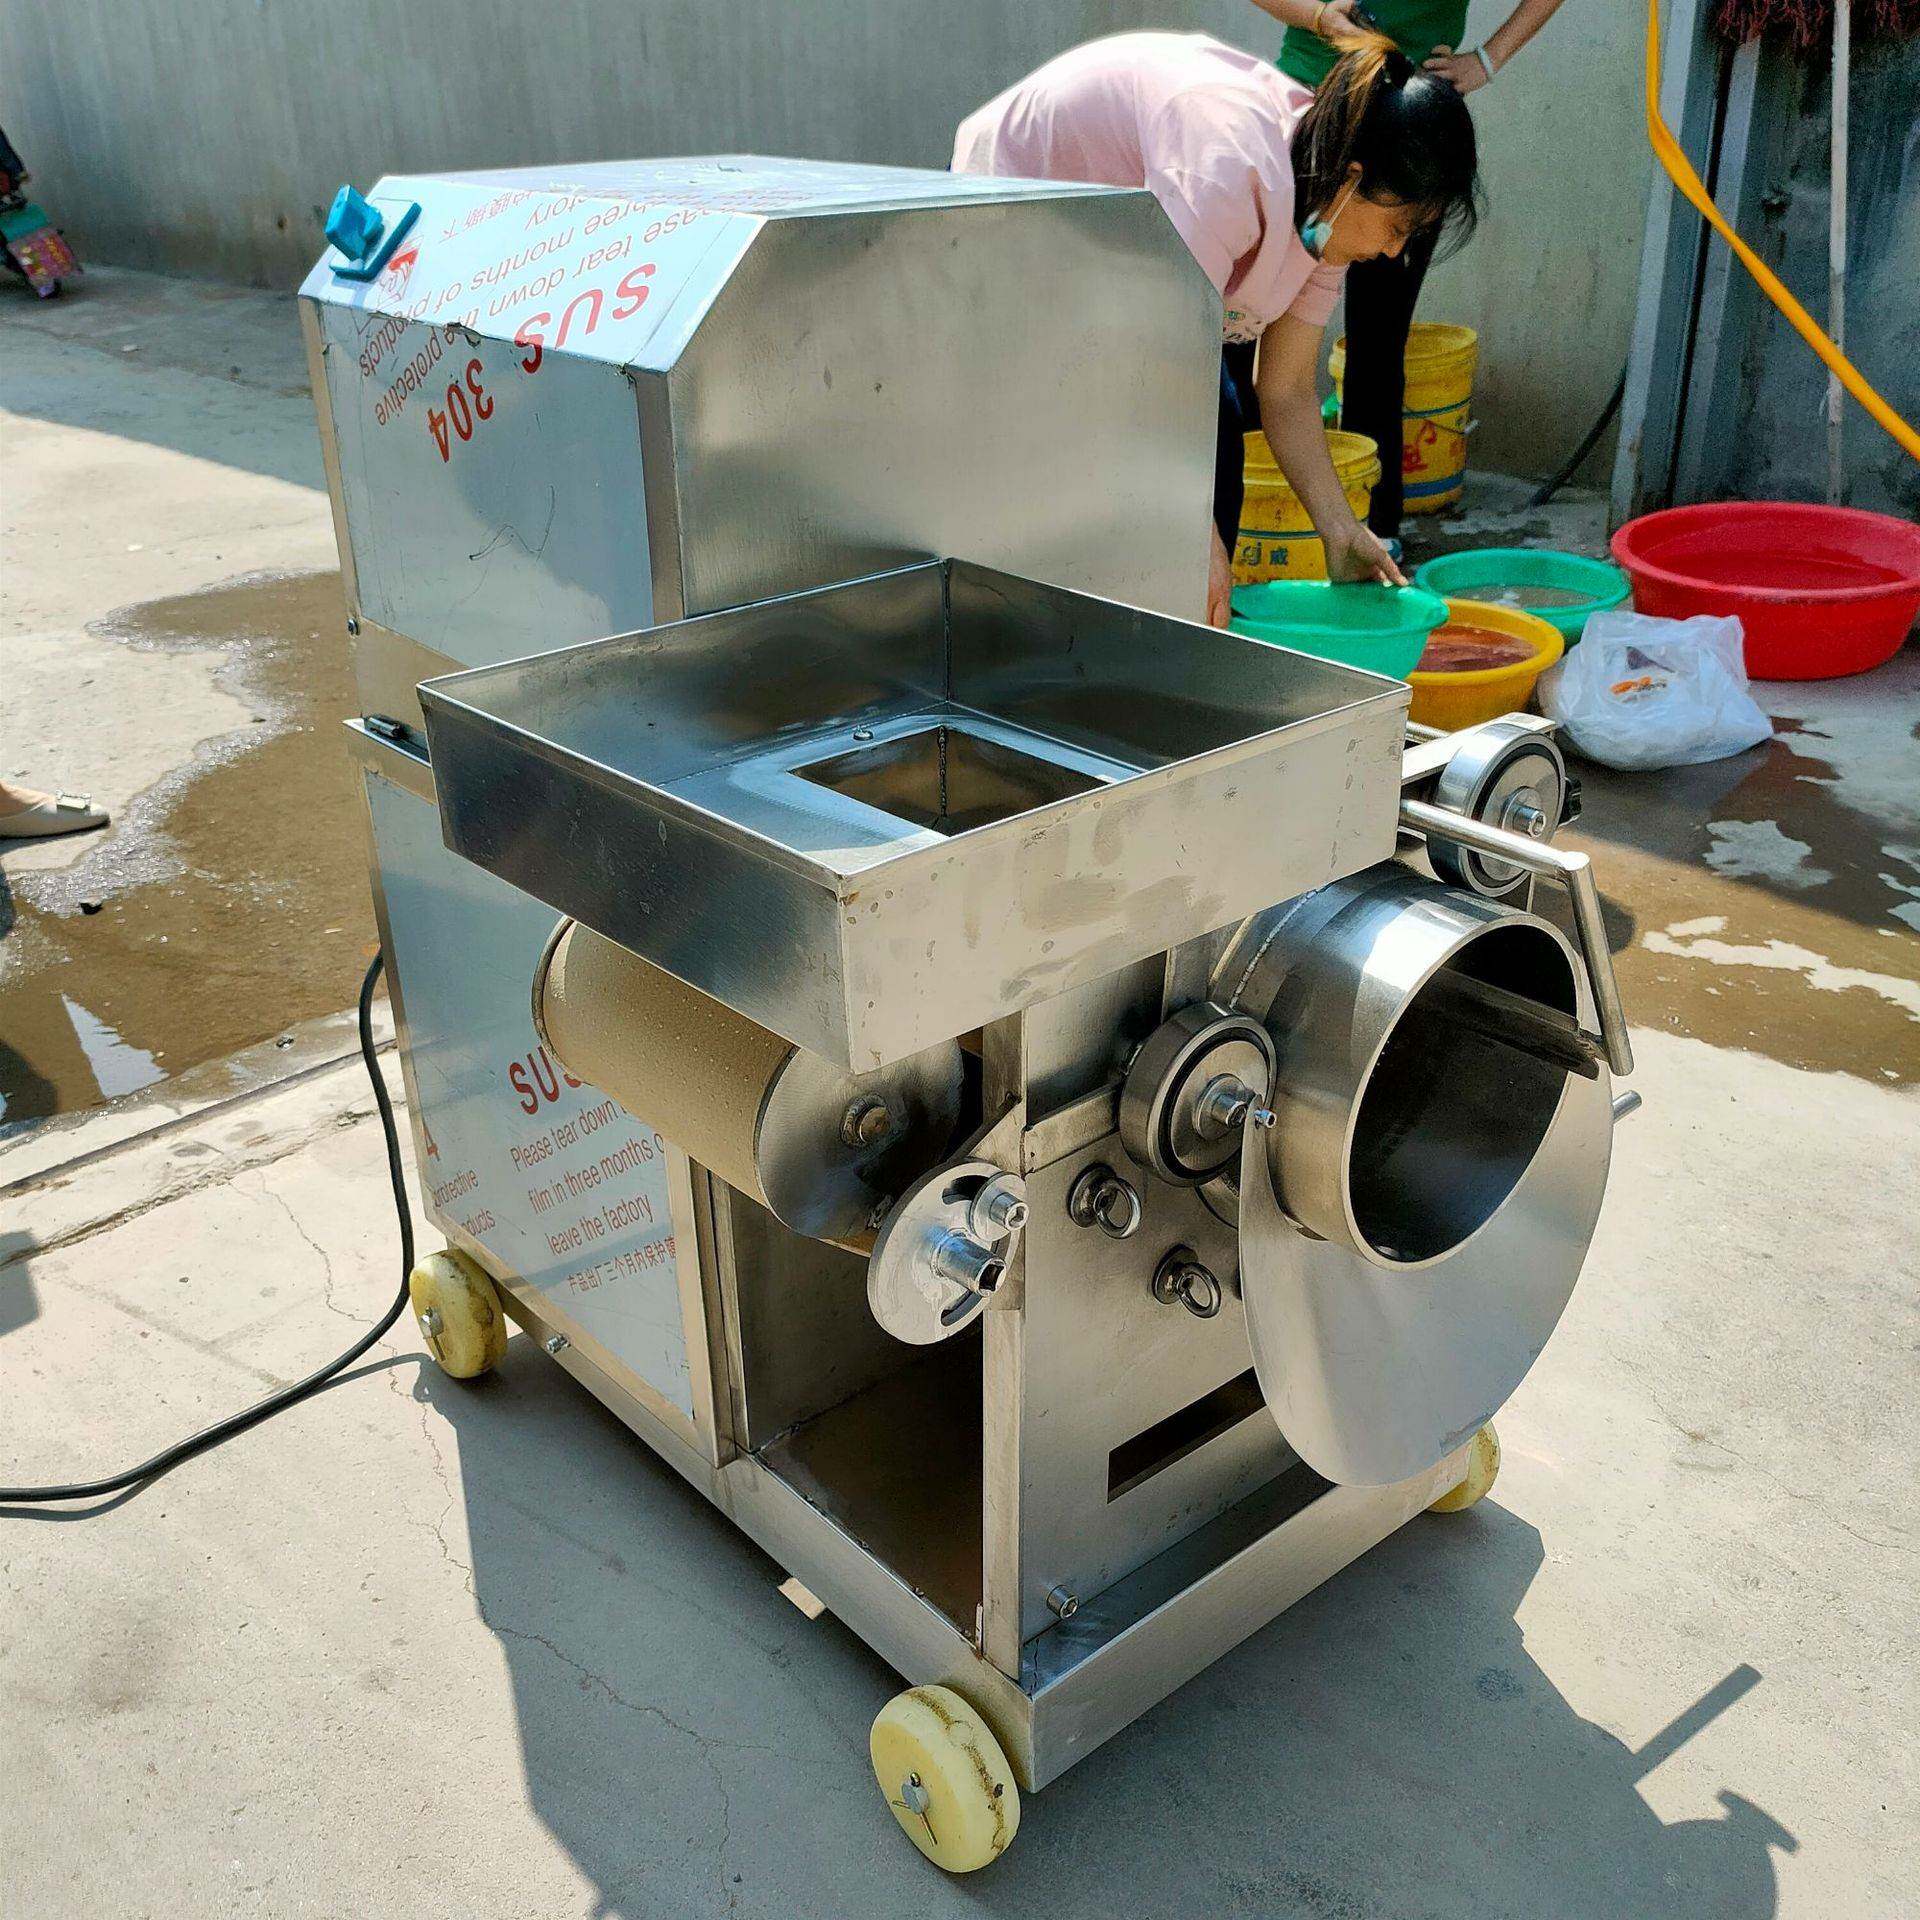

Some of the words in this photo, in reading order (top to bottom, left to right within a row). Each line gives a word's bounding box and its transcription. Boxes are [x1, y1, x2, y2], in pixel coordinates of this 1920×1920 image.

[584, 203, 647, 236] hree
[470, 227, 574, 290] months
[572, 235, 632, 278] tear
[434, 282, 462, 314] of
[489, 268, 565, 316] down
[514, 263, 656, 374] SUS
[375, 326, 445, 426] protective
[427, 358, 494, 463] 304
[510, 1134, 554, 1172] Please
[551, 1120, 581, 1149] tear
[579, 1100, 619, 1136] down
[528, 1184, 556, 1214] film
[551, 1177, 567, 1205] in
[565, 1164, 602, 1198] three
[600, 1137, 654, 1181] months
[544, 1228, 582, 1256] leave
[579, 1214, 605, 1242] the
[602, 1193, 654, 1232] factory
